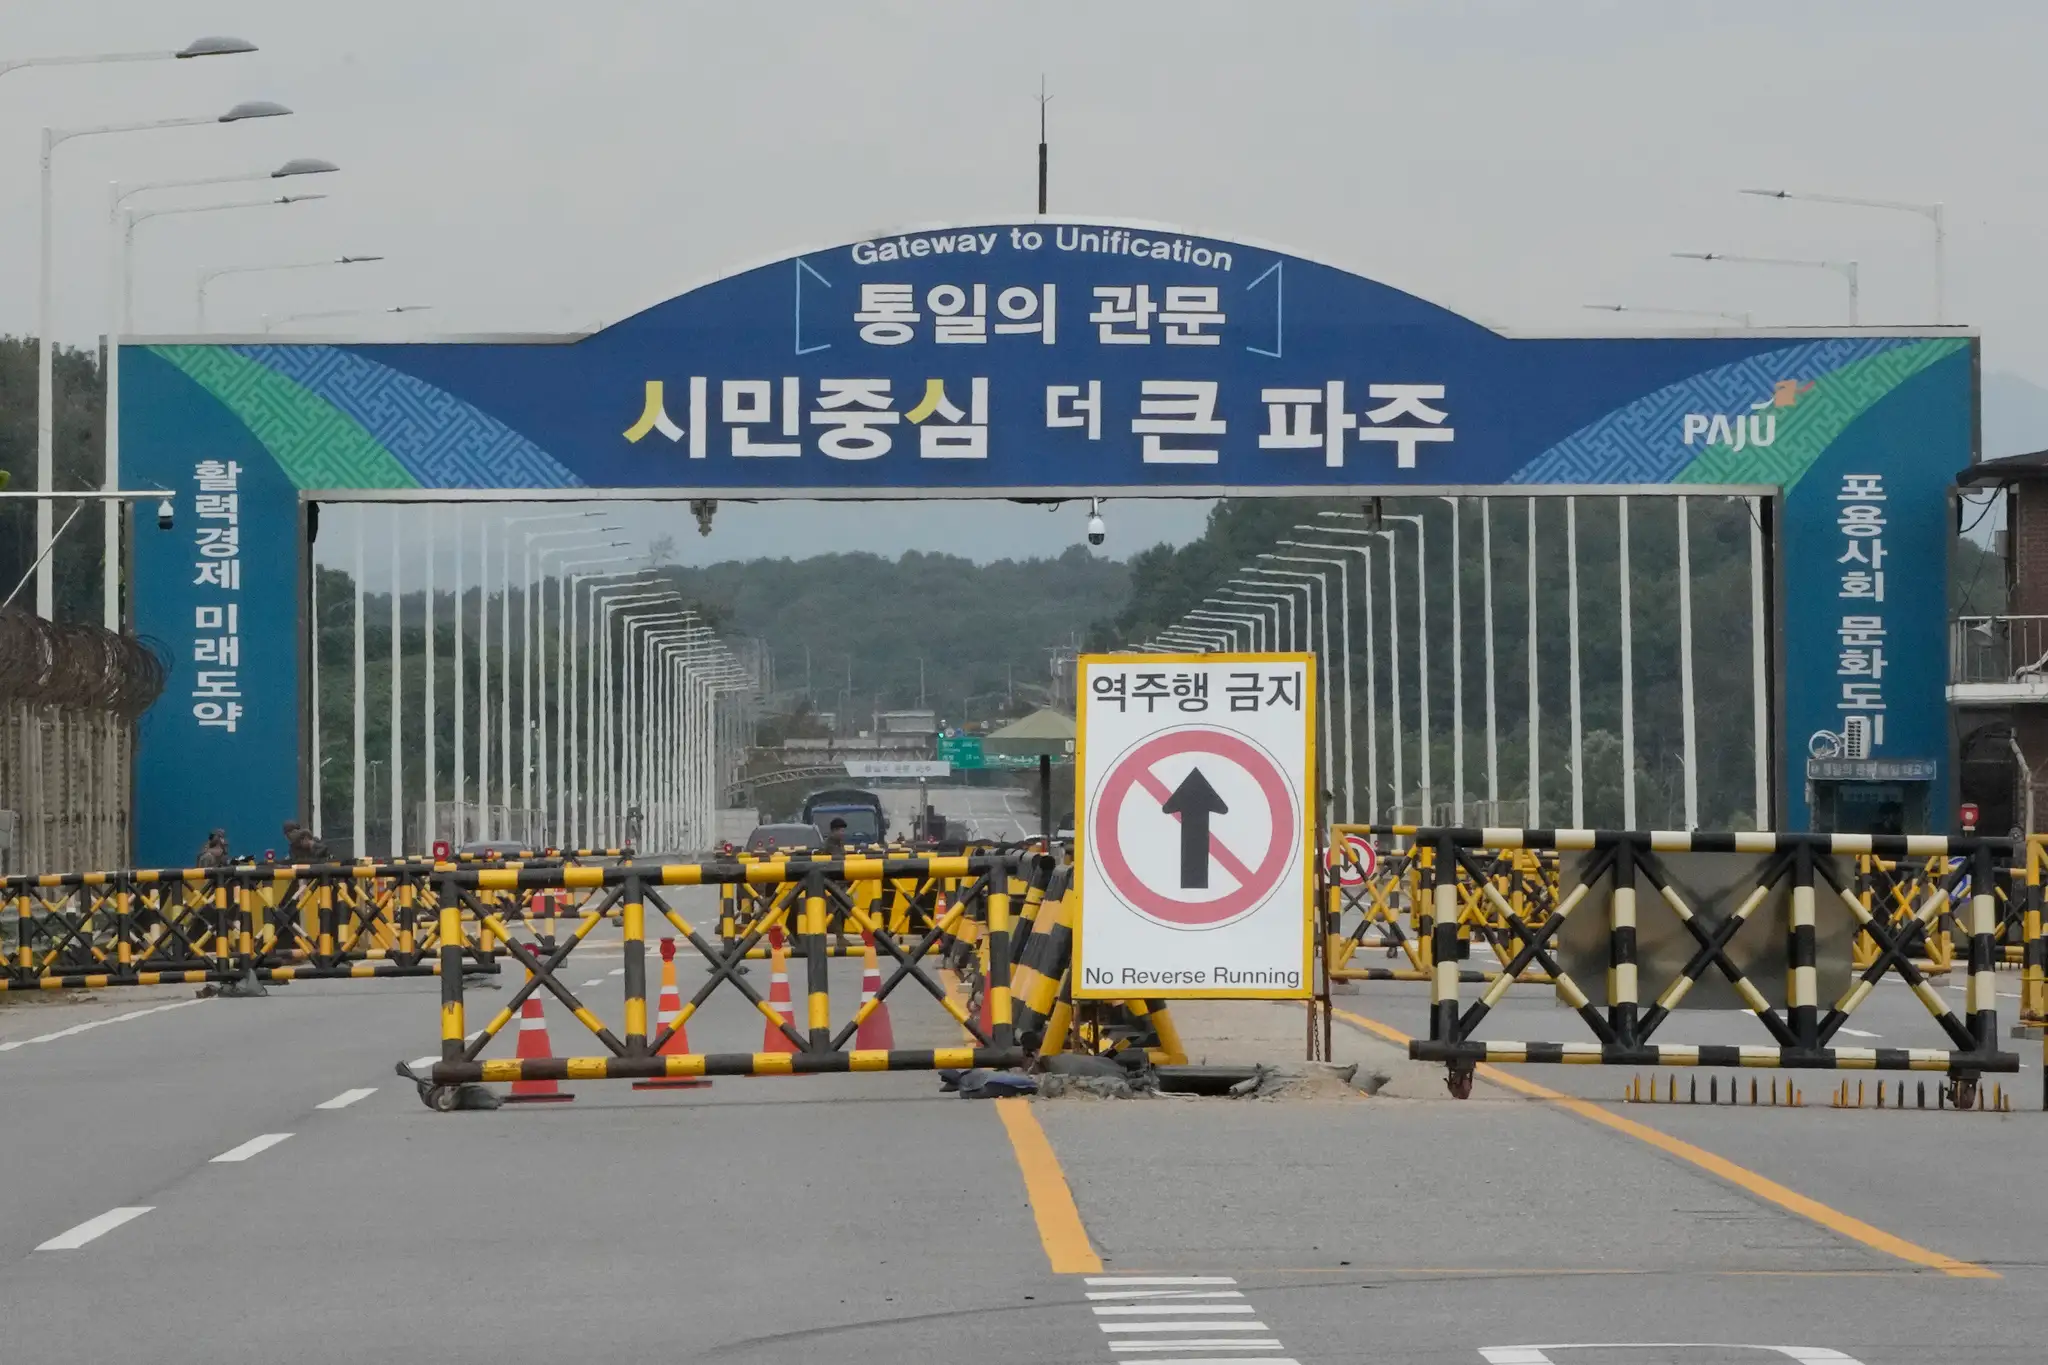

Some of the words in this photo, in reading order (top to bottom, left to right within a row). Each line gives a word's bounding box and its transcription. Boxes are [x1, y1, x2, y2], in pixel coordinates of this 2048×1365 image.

[851, 232, 997, 265] Gateway
[1010, 227, 1043, 251] to
[1056, 227, 1232, 271] Unification
[854, 283, 1056, 345] 통일의
[1090, 284, 1226, 345] 관문
[622, 377, 988, 460] 시민중심
[1046, 380, 1102, 440] 더
[1131, 380, 1227, 464] 큰
[1258, 380, 1455, 468] 파주
[1683, 413, 1776, 453] PAJU
[192, 460, 243, 590] 활력경제
[1837, 474, 1888, 602] 포용사회
[192, 603, 243, 732] 미래도약
[1092, 672, 1208, 712] 역주행
[1225, 671, 1301, 712] 금지
[1085, 967, 1114, 985] No
[1122, 967, 1206, 984] Reverse
[1214, 966, 1300, 988] Running
